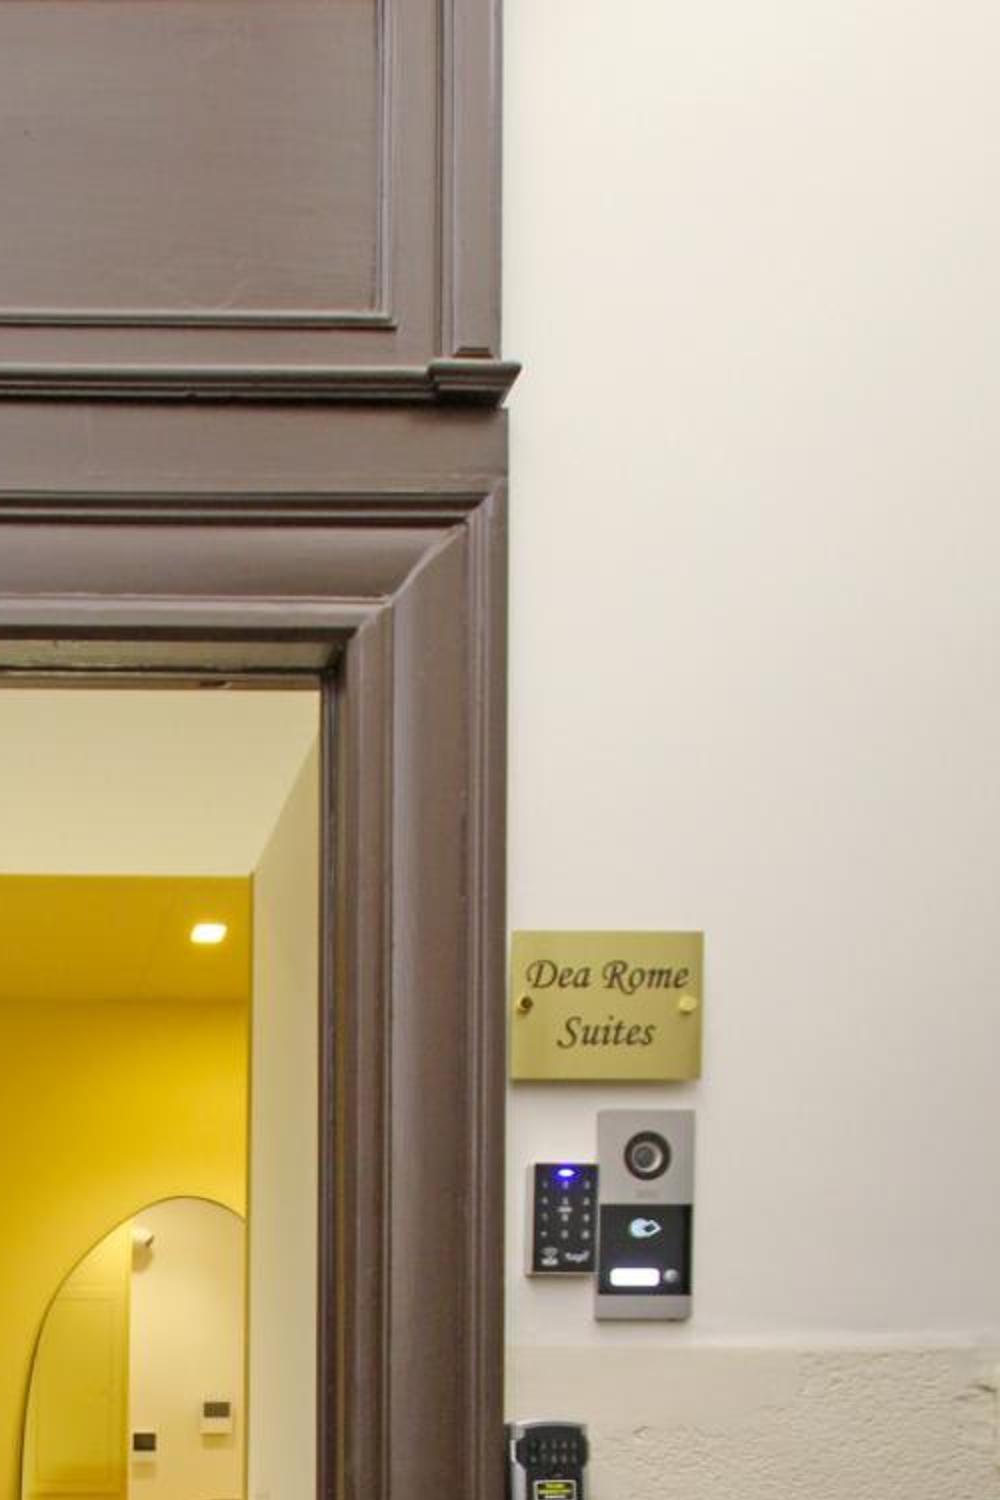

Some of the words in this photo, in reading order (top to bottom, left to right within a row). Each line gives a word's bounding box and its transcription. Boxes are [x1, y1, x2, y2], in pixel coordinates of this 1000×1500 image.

[526, 959, 591, 989] Dea
[602, 959, 689, 995] Rome
[556, 1015, 657, 1049] Suites
